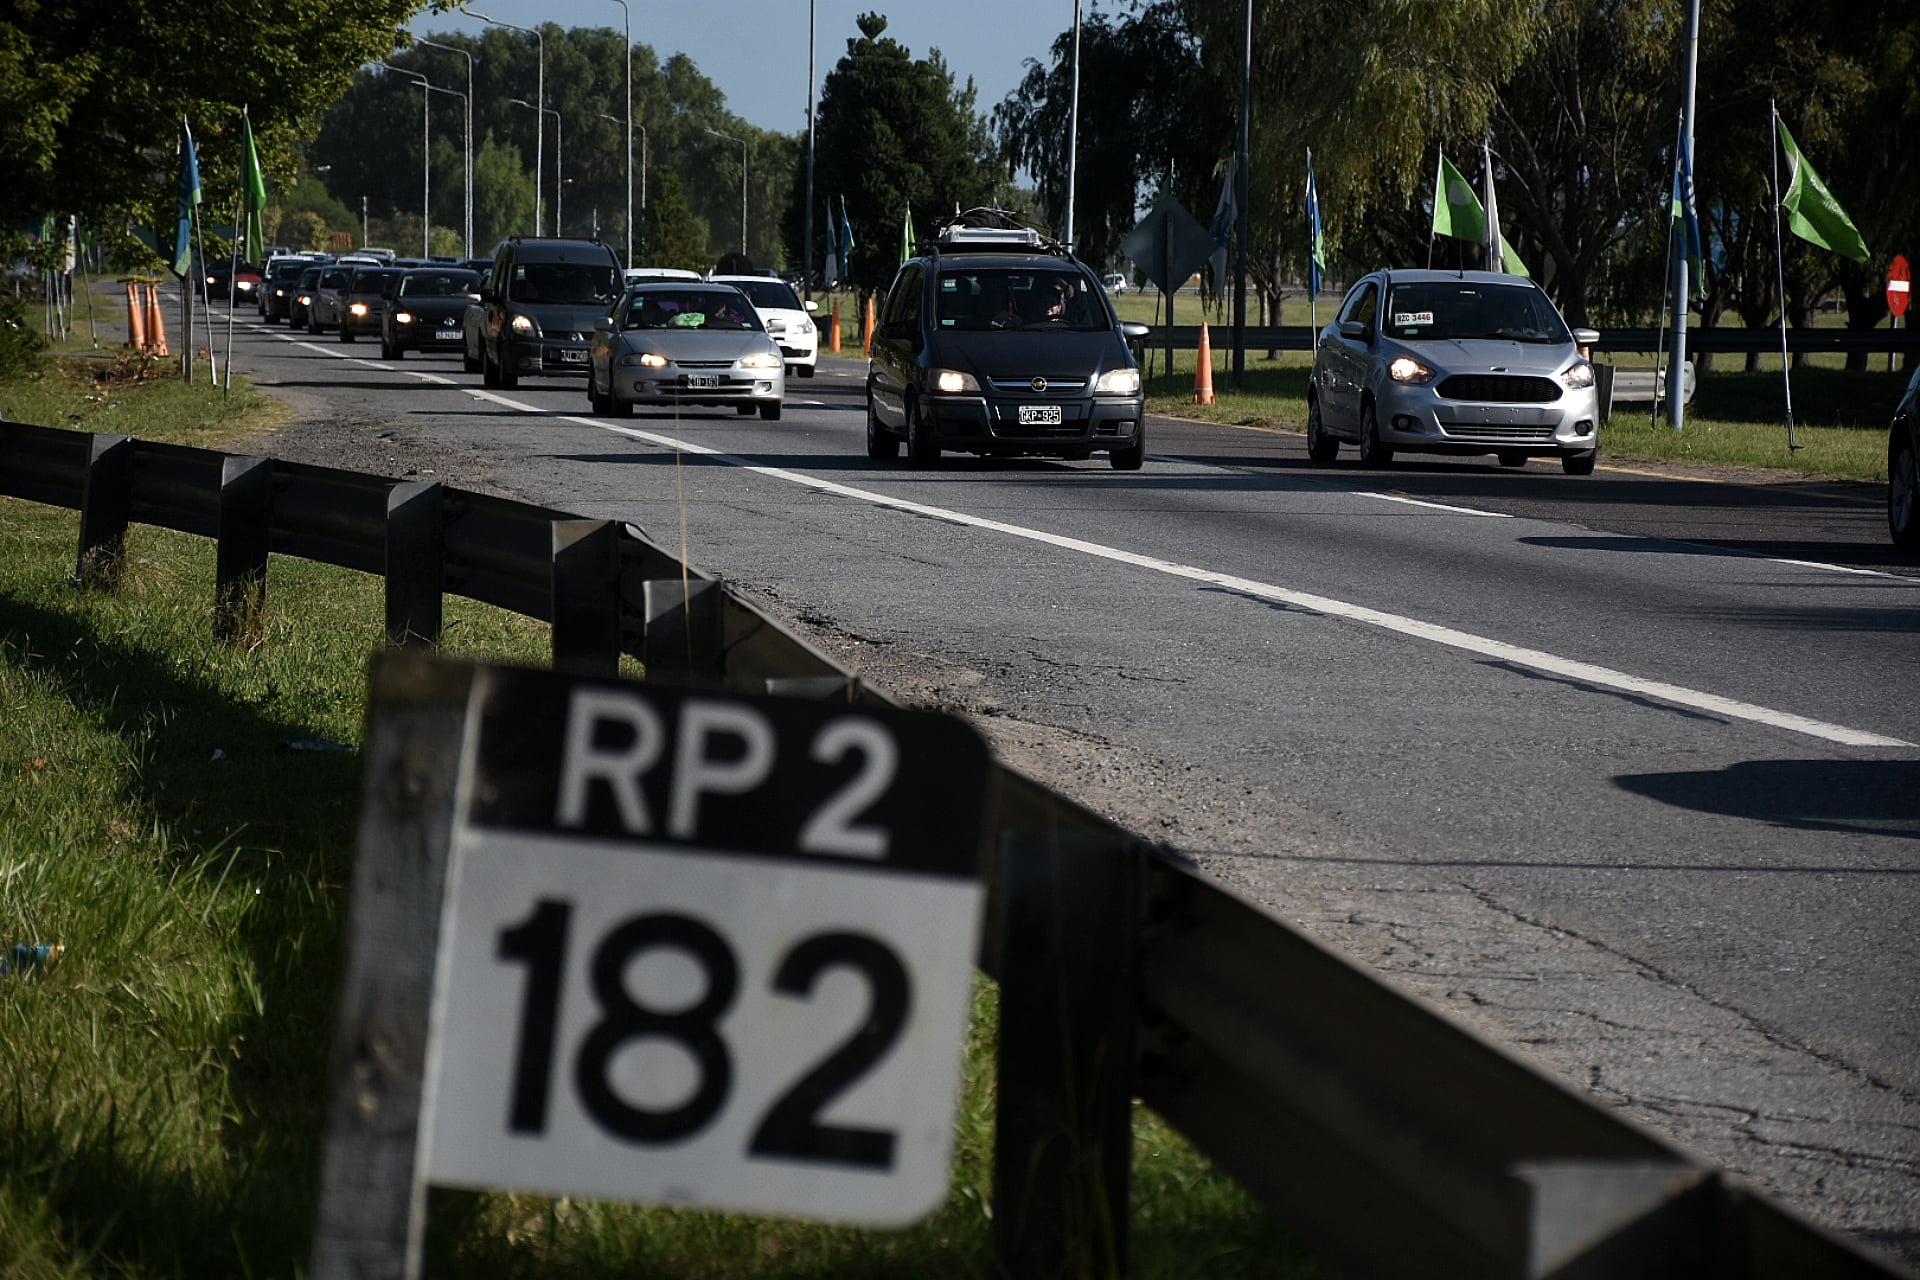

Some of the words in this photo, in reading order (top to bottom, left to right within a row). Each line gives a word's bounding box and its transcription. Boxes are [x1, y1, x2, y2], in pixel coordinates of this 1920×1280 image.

[555, 687, 776, 839] RP
[799, 716, 898, 859] 2
[494, 895, 914, 1174] 182
